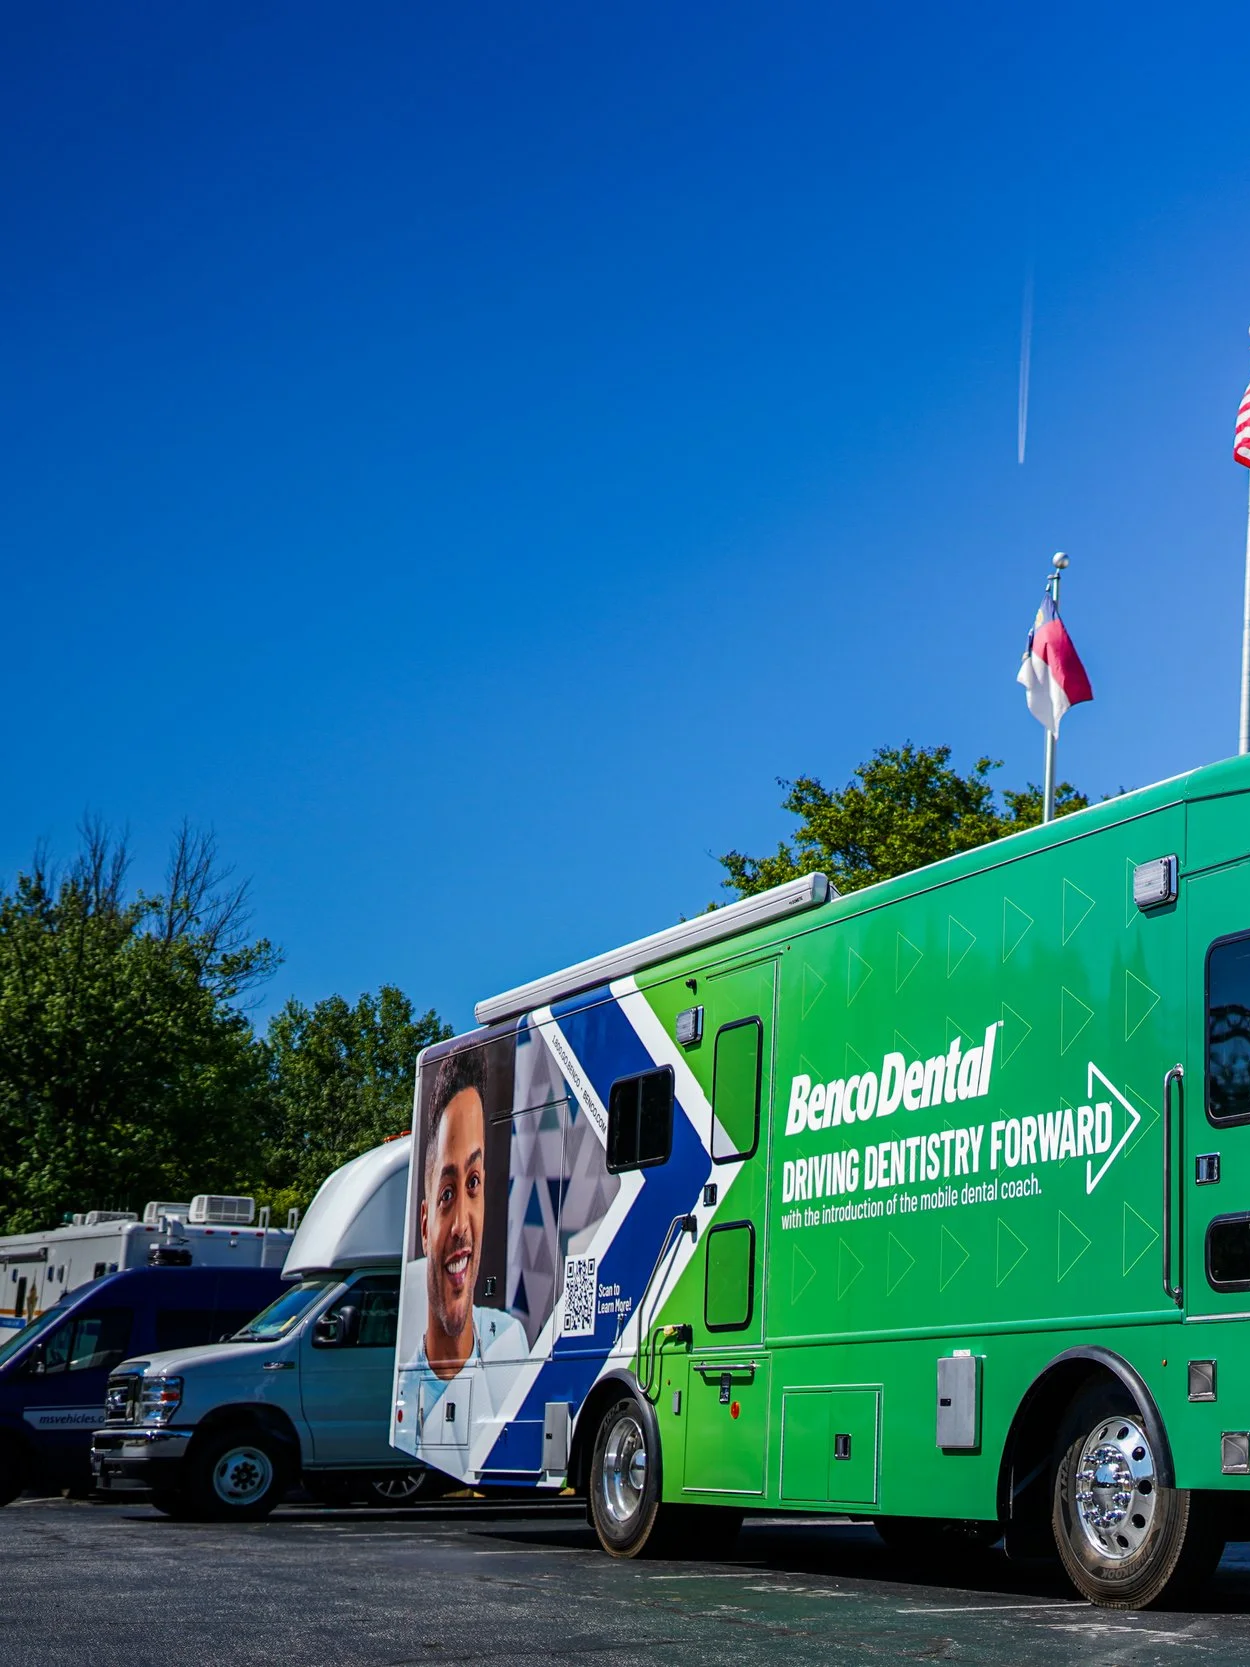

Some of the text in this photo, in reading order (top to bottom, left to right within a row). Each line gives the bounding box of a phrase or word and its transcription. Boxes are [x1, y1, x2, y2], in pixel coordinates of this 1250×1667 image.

[784, 1021, 998, 1136] BencoDental
[781, 1102, 1112, 1204] DRIVING DENTISTRY FORWARD
[781, 1172, 1043, 1230] with the introduction of the mobile dental coach.
[597, 1297, 632, 1314] Learn More!
[598, 1283, 620, 1298] Scan to
[39, 1413, 106, 1425] msvehicles.co
